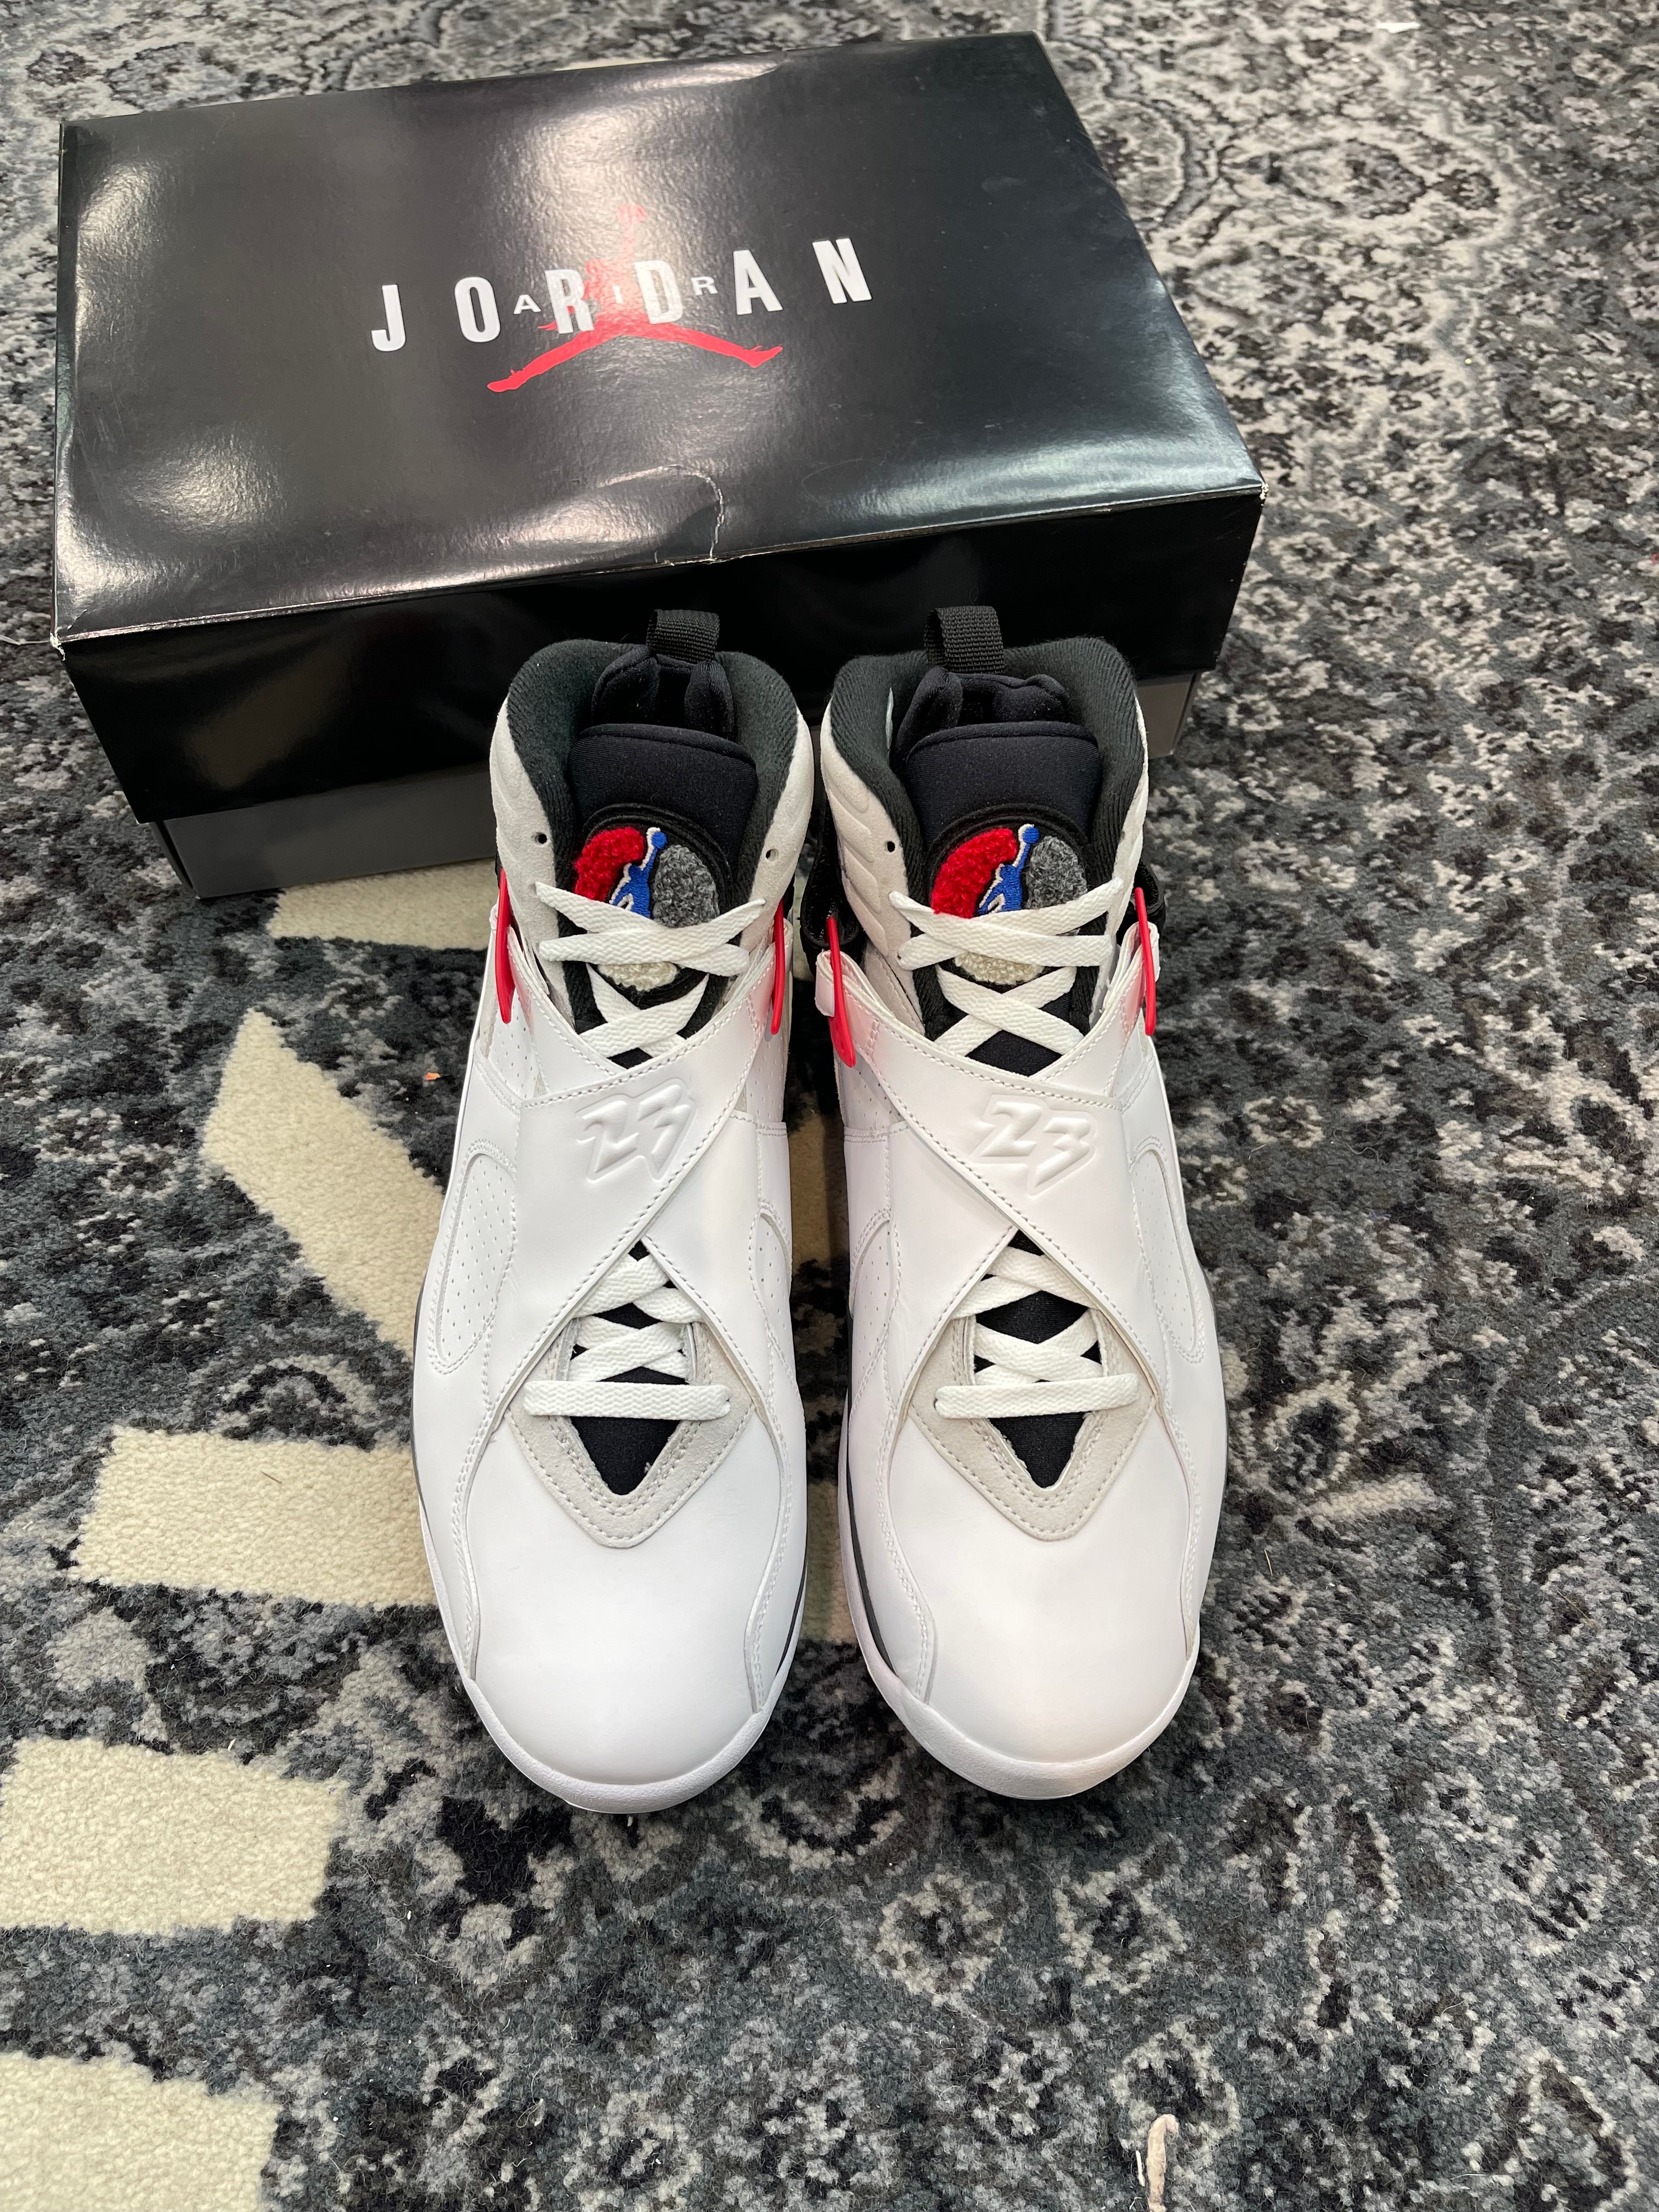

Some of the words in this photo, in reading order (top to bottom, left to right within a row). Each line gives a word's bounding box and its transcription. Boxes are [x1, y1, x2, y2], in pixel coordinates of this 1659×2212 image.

[371, 237, 872, 352] JORDAN
[513, 276, 719, 314] AIR
[580, 1084, 691, 1174] 23
[980, 1101, 1091, 1188] 23
